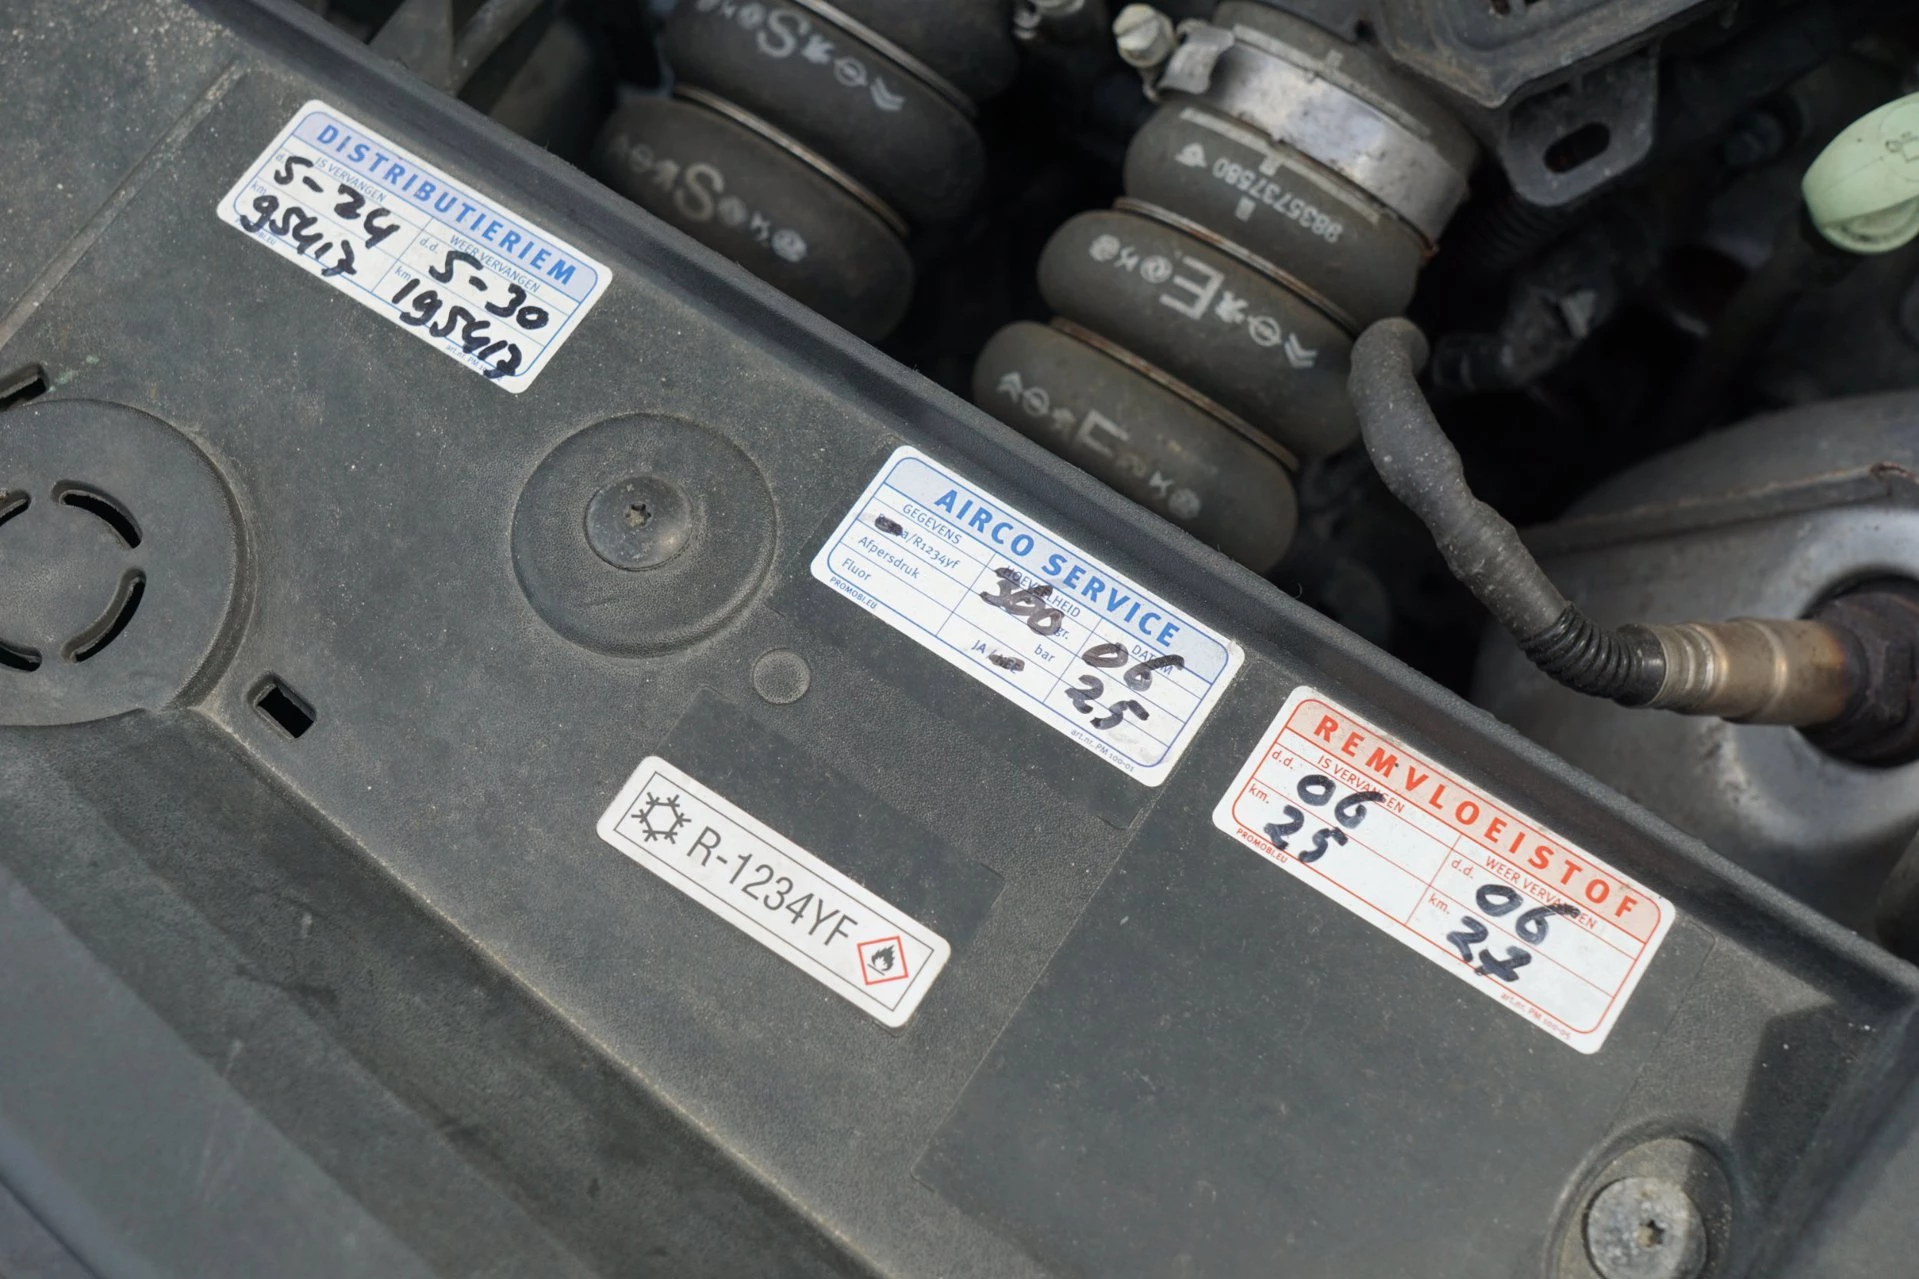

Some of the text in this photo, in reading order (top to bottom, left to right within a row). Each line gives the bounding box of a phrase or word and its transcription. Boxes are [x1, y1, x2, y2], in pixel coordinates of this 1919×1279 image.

[328, 162, 387, 202] VERVANGEN
[317, 124, 577, 286] DISTRIBUTIERIEM
[451, 235, 541, 293] WEER VERVANGEN
[903, 503, 962, 545] GEGEVENS
[841, 558, 872, 581] Fluor
[858, 536, 920, 579] Afpersdruk
[934, 489, 1181, 647] AIRCO SERVICE
[830, 576, 878, 610] PROMOBI.EU
[970, 639, 985, 654] JA
[1034, 643, 1055, 663] bar
[1081, 642, 1185, 692] 06
[1131, 644, 1173, 676] DATM
[1064, 674, 1150, 730] 25
[1095, 742, 1110, 756] PM
[1271, 749, 1294, 770] d.d.
[1317, 754, 1331, 769] IS
[1249, 783, 1270, 804] km.
[1296, 774, 1387, 829] 06
[1263, 804, 1348, 863] 25
[1313, 714, 1637, 918] REMVLOEISTOF
[1236, 827, 1288, 864] PROMOBI.EU
[686, 825, 858, 946] R-1234YF
[1451, 857, 1474, 879] d.d.
[1427, 893, 1450, 915] km.
[1485, 855, 1597, 930] WEER VERVAEN
[1475, 883, 1581, 946] 06
